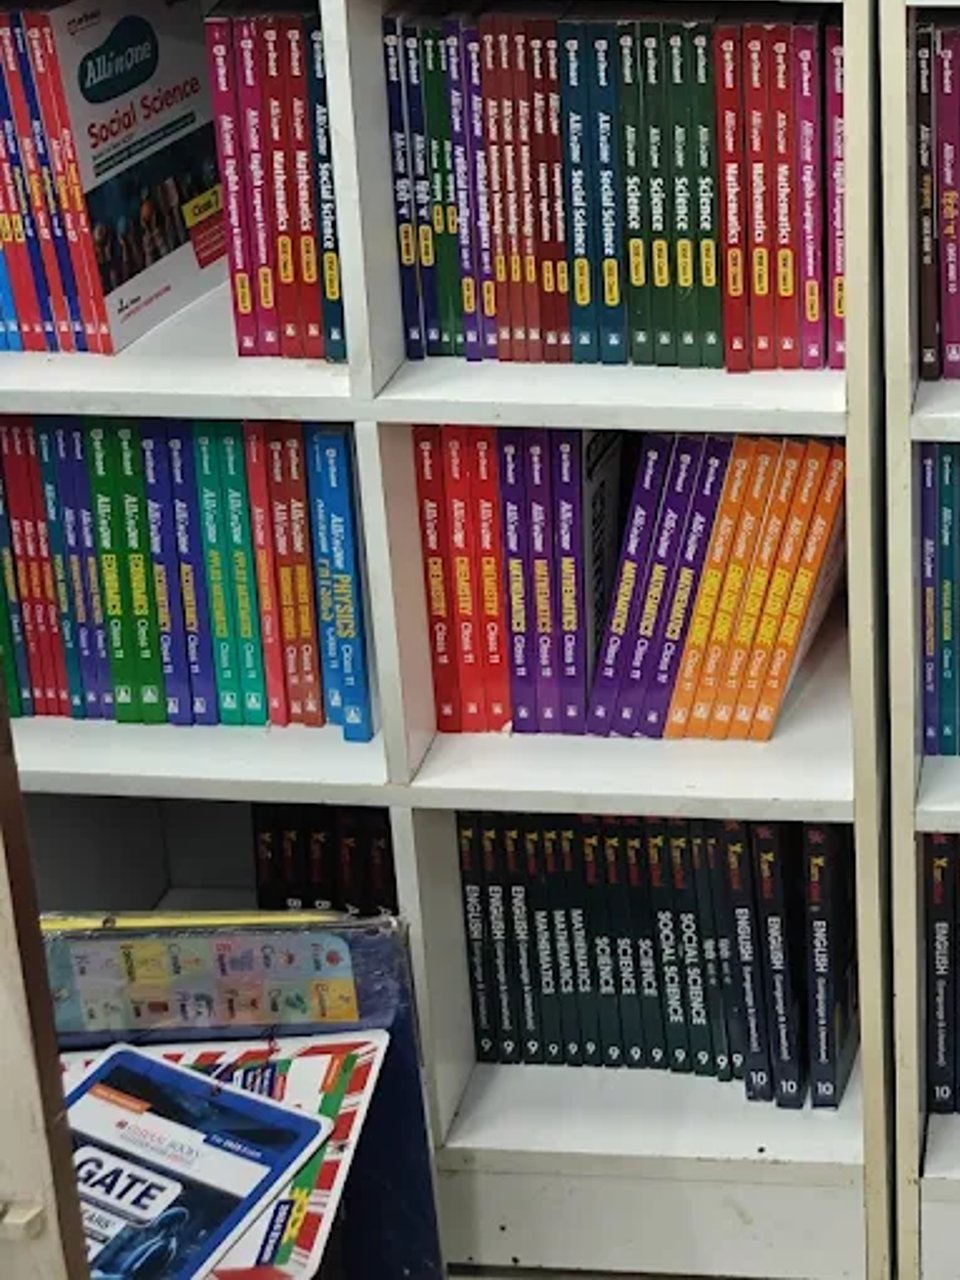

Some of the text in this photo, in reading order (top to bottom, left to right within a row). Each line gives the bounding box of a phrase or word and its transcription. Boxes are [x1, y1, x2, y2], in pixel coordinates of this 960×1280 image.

[88, 102, 139, 149] Social
[141, 77, 200, 119] Science
[319, 162, 334, 248] Social Science
[570, 171, 586, 256] Social Science
[626, 176, 641, 229] Science
[699, 176, 713, 230] Science
[726, 162, 739, 245] Mathematics
[334, 574, 355, 638] PHYSICS
[512, 887, 528, 938] ENGLISH
[595, 937, 615, 994] SCIENCE
[639, 938, 657, 996] SCIENCE
[657, 910, 683, 1022] SOCIAL SCIENCE
[680, 913, 706, 1024] SOCIAL SCIENCE
[768, 917, 783, 970] ENGLISH
[935, 922, 949, 974] ENGLISH
[609, 1046, 618, 1059] 9
[751, 1072, 767, 1085] 10
[817, 1082, 833, 1095] 10
[76, 1157, 168, 1211] GATE
